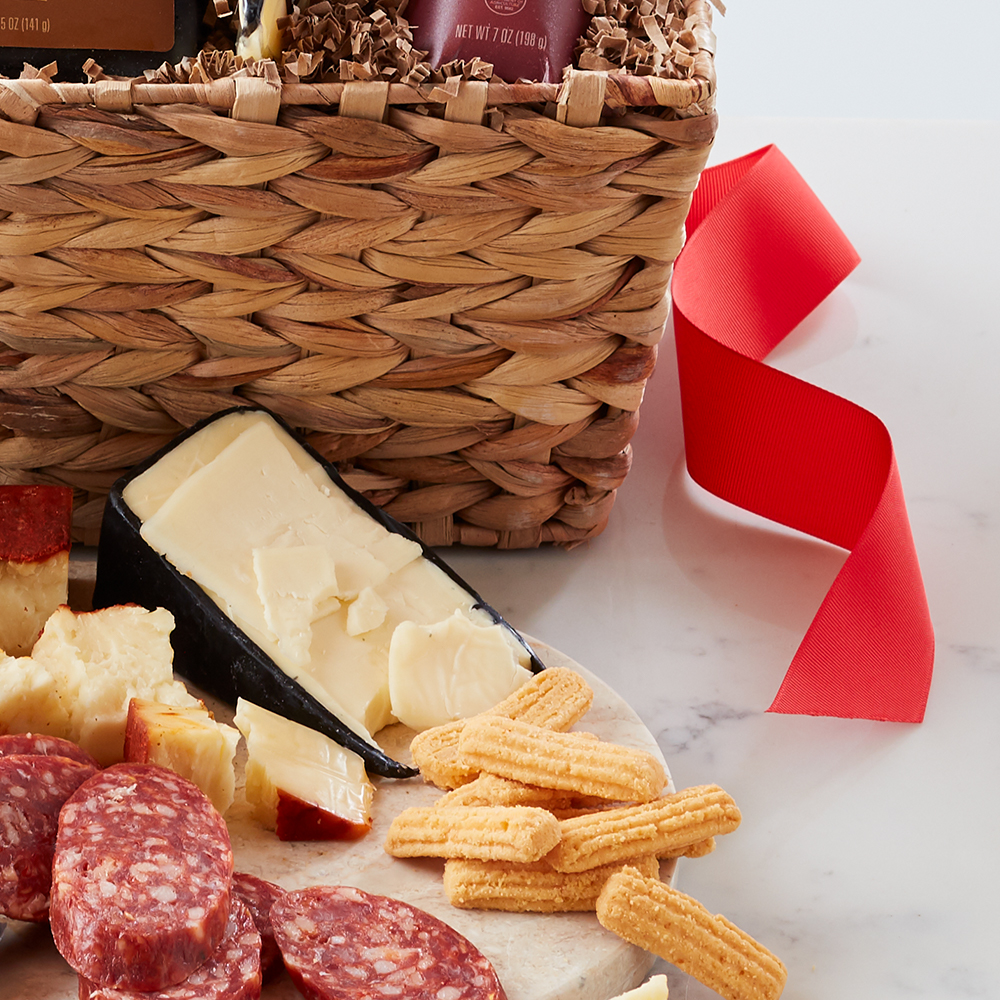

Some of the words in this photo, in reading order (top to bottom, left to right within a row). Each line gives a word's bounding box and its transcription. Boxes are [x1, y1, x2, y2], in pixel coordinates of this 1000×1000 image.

[0, 16, 6, 30] 5
[8, 16, 19, 31] OZ
[21, 16, 40, 33] (141
[41, 17, 51, 33] g)
[455, 24, 473, 38] NET
[475, 25, 490, 40] WT
[493, 27, 499, 41] 7
[501, 27, 513, 44] OZ
[515, 31, 536, 47] (198
